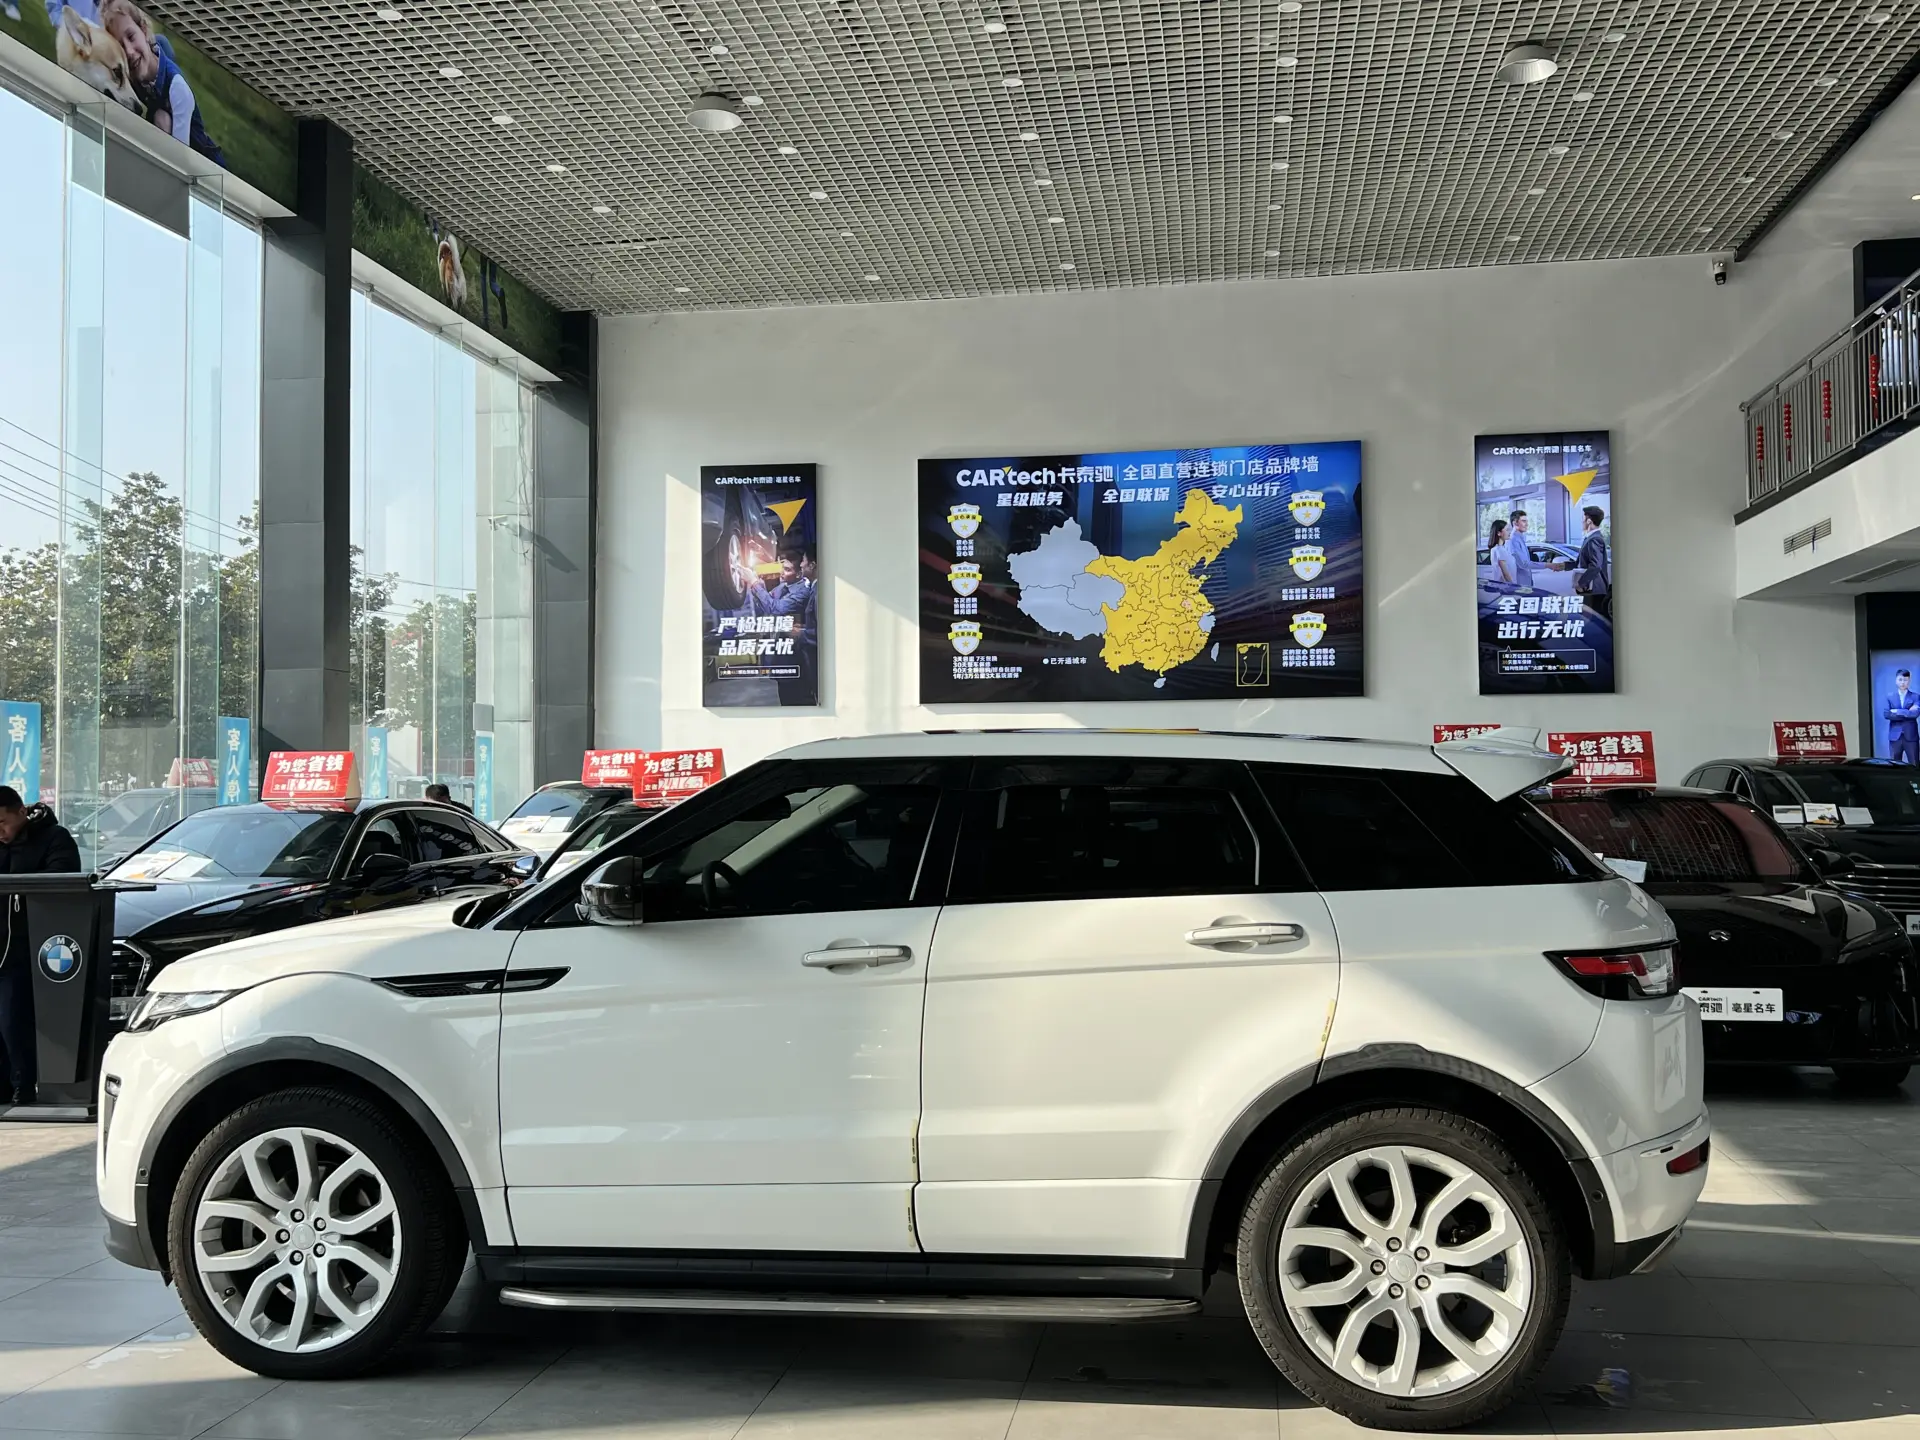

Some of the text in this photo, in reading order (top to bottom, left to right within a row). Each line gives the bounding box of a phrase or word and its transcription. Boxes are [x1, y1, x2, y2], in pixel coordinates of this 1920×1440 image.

[1057, 466, 1114, 484] 卡泰驰
[1123, 456, 1319, 482] 全国直营连锁门店品牌墙
[996, 482, 1280, 507] 星级服务 全国联保 安心出行
[1497, 596, 1584, 615] 全国联保
[718, 615, 794, 633] 严检保障
[1498, 620, 1585, 638] 出行无忧
[718, 638, 794, 655] 品质无忧
[1782, 724, 1837, 738] 为您省钱
[1560, 735, 1644, 757] 为您省钱
[276, 754, 344, 774] 为您省钱
[590, 751, 636, 766] 为您省钱
[644, 751, 714, 774] 为您省钱
[43, 937, 78, 952] BMW
